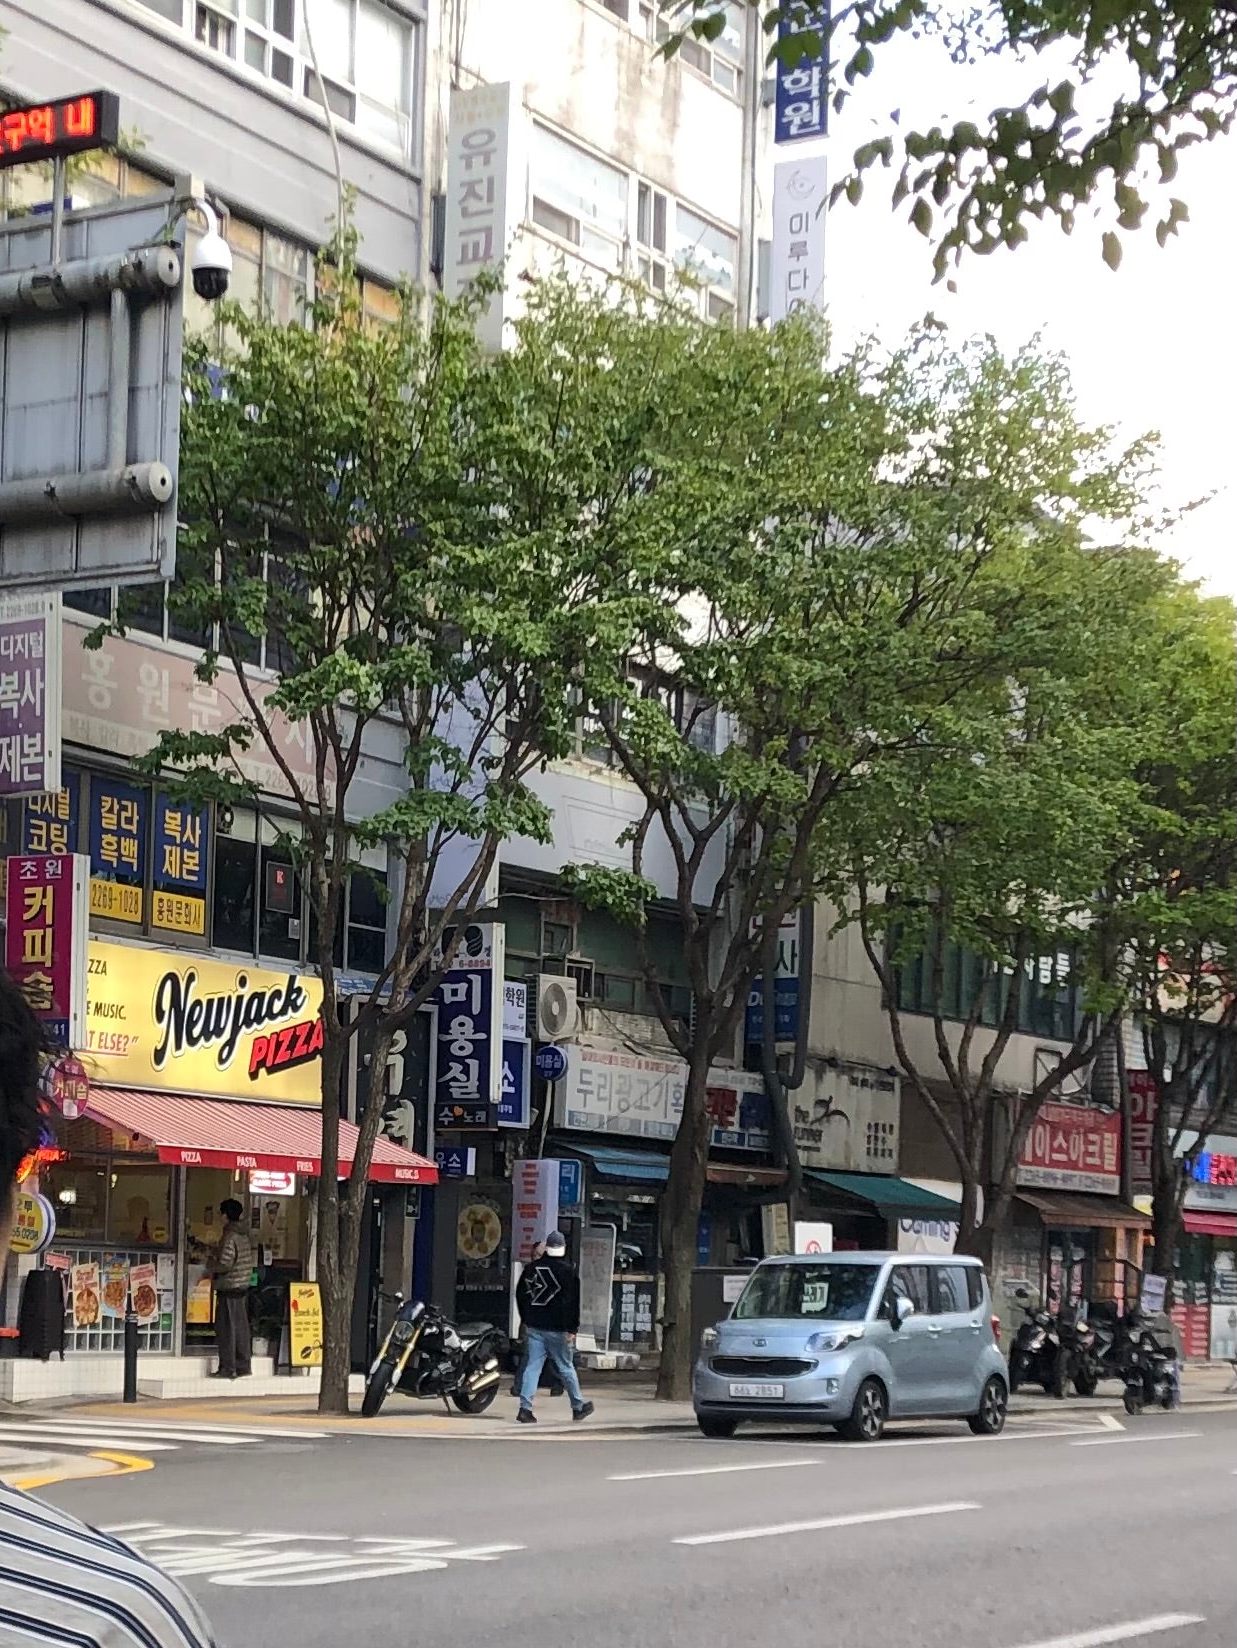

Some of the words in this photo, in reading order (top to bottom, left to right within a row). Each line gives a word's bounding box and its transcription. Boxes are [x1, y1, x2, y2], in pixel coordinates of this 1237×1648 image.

[65, 97, 96, 138] 내
[456, 128, 498, 291] 유진교
[0, 630, 44, 662] 디지털
[72, 645, 314, 766] 홍원문사
[100, 795, 140, 835] 칼라
[163, 808, 202, 848] 복사
[27, 818, 68, 856] 코팅
[99, 833, 139, 872] 흑백
[19, 859, 63, 880] 초원
[162, 843, 200, 882] 제본
[91, 883, 140, 916] 2269-1028
[21, 884, 56, 1011] 커피숍
[153, 970, 307, 1068] Newjack
[436, 973, 489, 1100] 미용실
[249, 1018, 324, 1076] PIZZA
[180, 1150, 202, 1163] PIZZA
[236, 1155, 258, 1168] PASTA
[296, 1160, 314, 1173] FRIES
